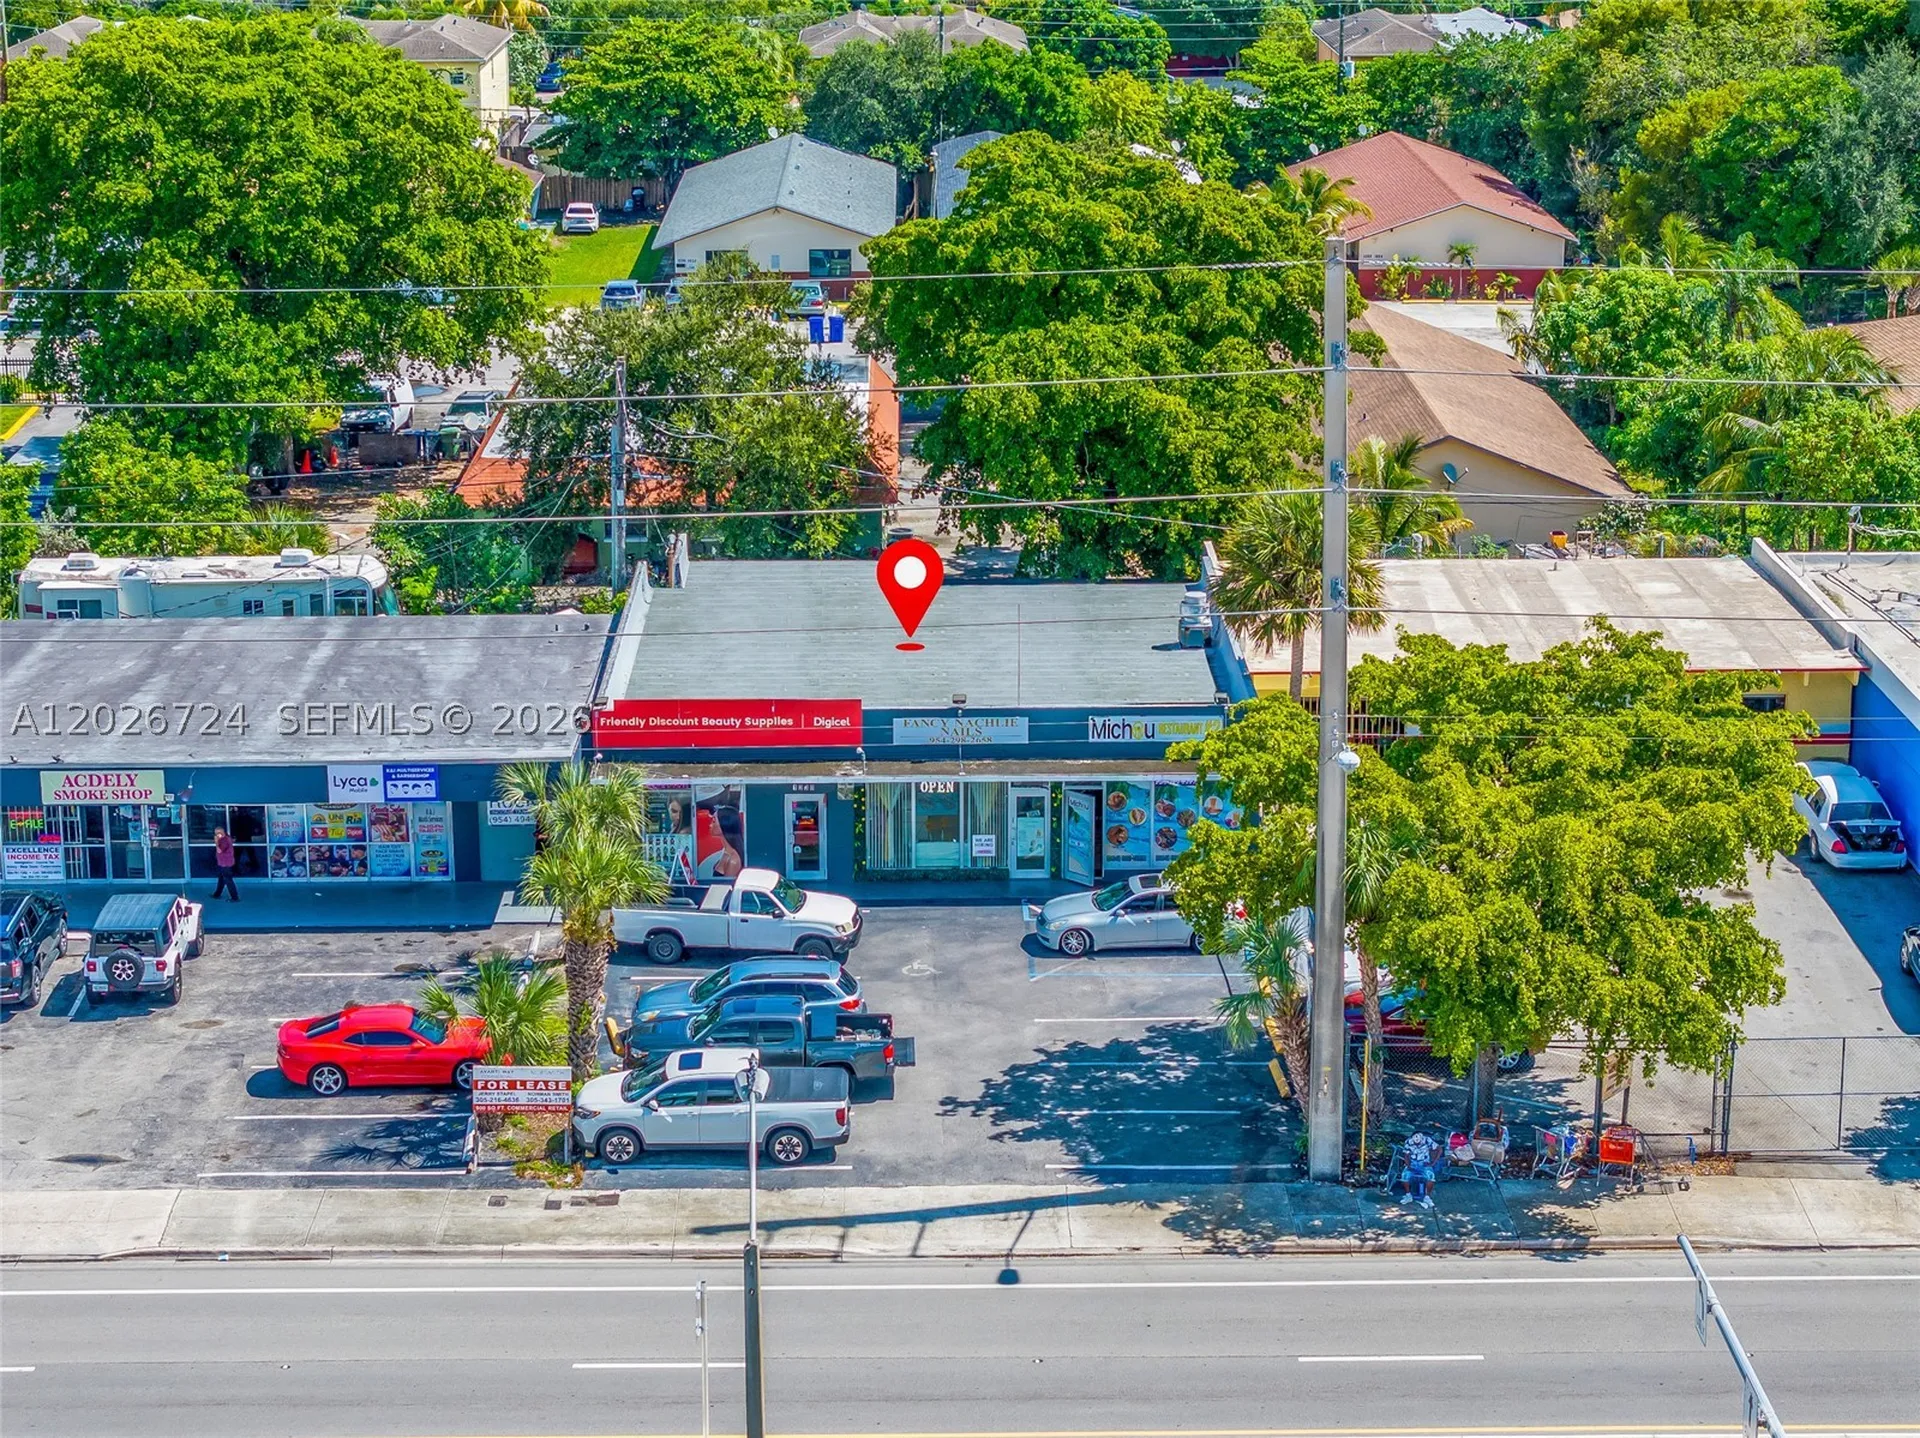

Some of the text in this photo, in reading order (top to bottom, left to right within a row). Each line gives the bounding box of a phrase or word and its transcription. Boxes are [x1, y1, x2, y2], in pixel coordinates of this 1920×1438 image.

[600, 717, 794, 729] Friendly Discount Beauty Supplies
[813, 716, 851, 728] Digicel
[903, 718, 1018, 727] FANCY NACHLIE
[941, 727, 983, 736] NAILS
[1090, 718, 1155, 740] Michou
[62, 773, 139, 788] ACDELY
[333, 775, 368, 789] Lyca
[920, 781, 955, 793] OPEN
[54, 789, 153, 800] SMOKE SHOP
[489, 816, 511, 824] (954)
[477, 1081, 567, 1090] FOR LEASE
